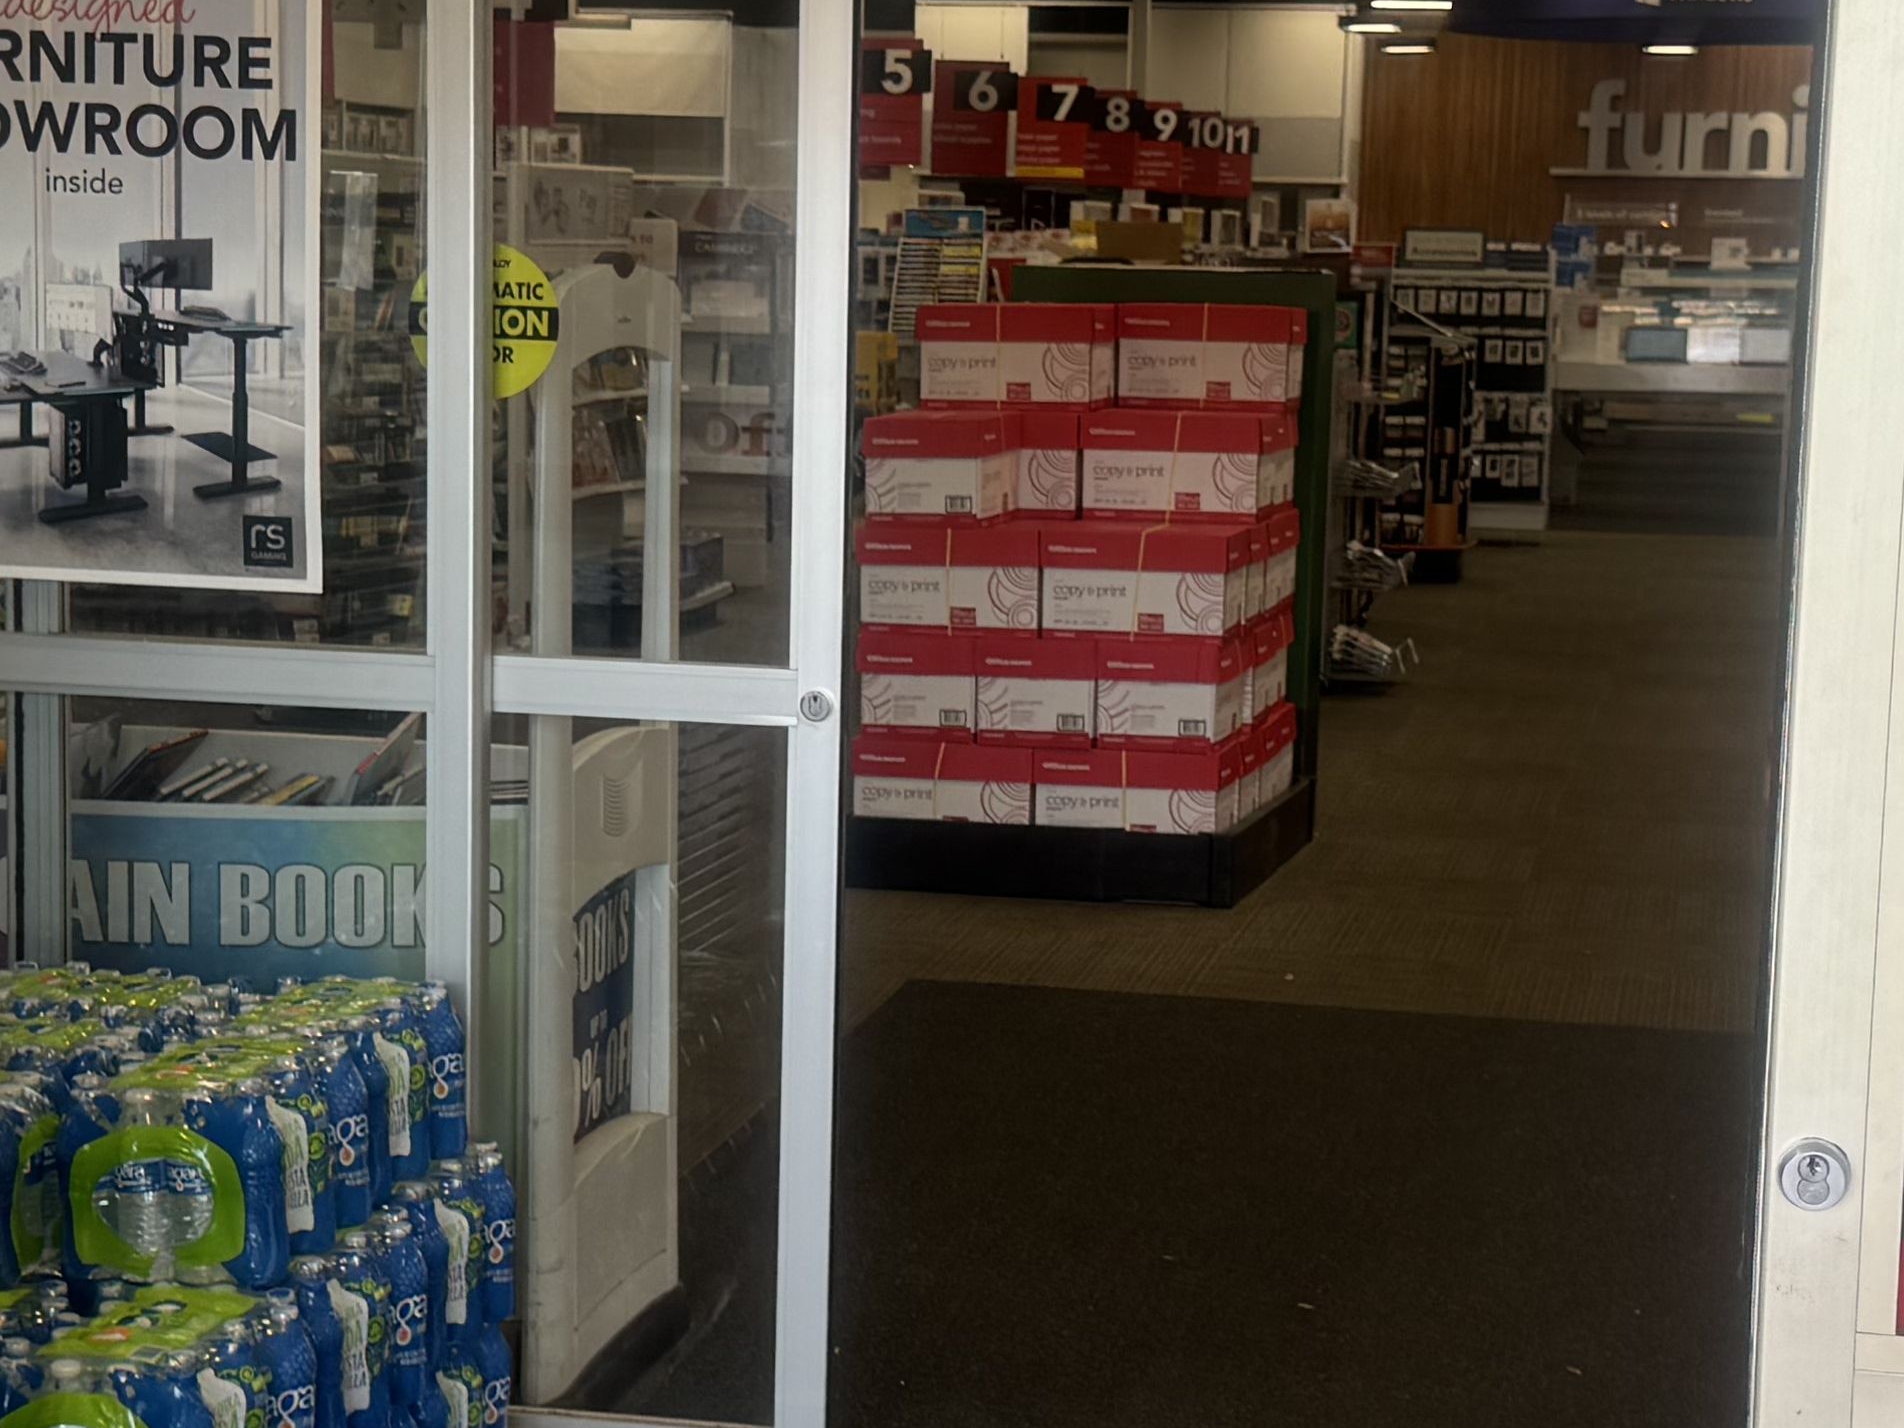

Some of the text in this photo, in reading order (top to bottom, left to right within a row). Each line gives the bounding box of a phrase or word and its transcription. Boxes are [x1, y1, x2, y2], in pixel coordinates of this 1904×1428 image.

[881, 48, 914, 95] 5
[968, 70, 999, 112] 6
[1050, 83, 1081, 122] 7
[1105, 96, 1131, 134] 8
[1152, 109, 1179, 143] 9
[1578, 77, 1808, 174] furni
[1189, 117, 1225, 150] 10
[44, 168, 124, 196] inside
[868, 579, 940, 596] copy print
[1052, 583, 1127, 600] copy print
[862, 785, 933, 802] copy print
[1045, 794, 1120, 811] copy print
